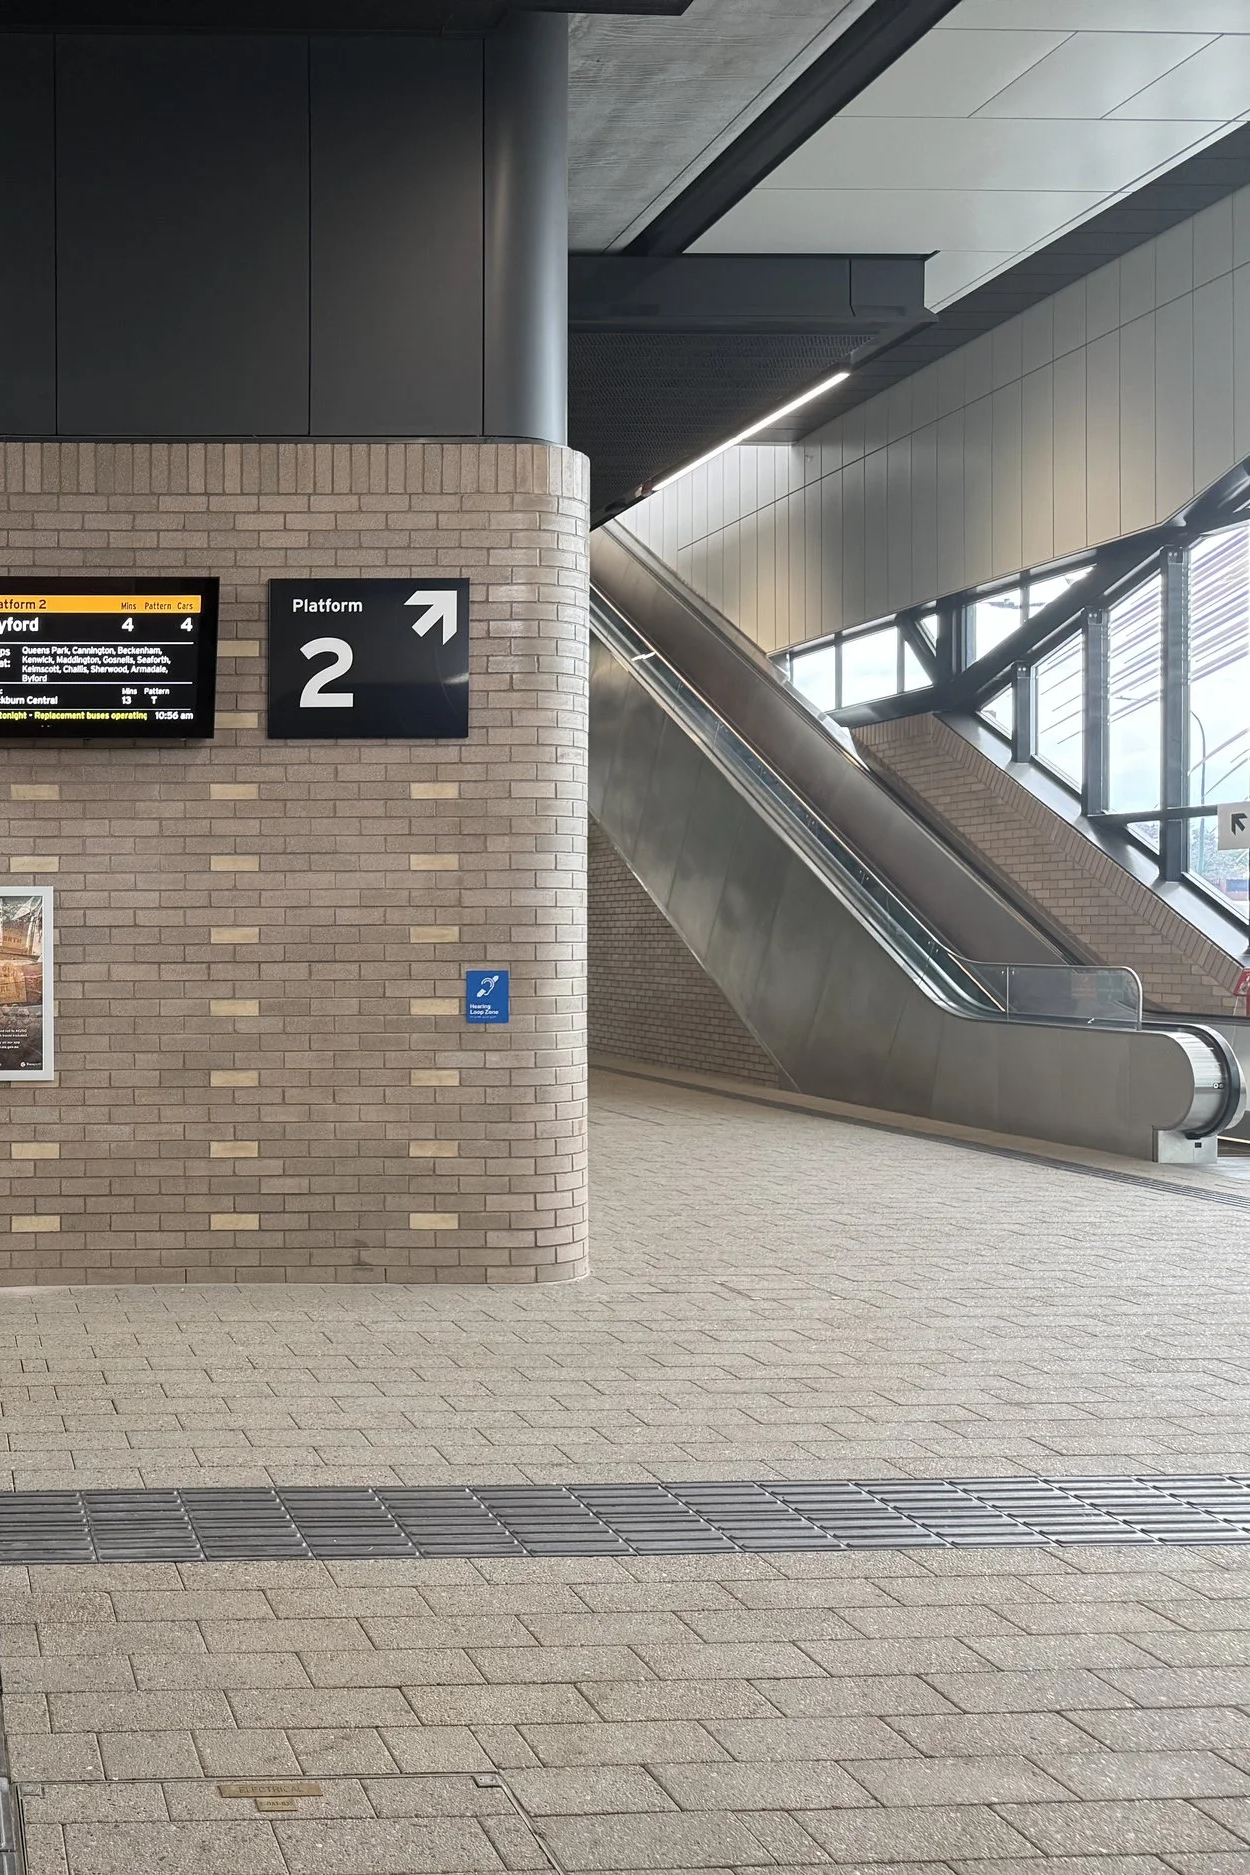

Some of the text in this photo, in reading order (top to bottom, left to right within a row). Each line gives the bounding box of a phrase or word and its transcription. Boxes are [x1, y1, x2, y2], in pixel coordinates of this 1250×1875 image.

[39, 600, 47, 610] 2
[121, 602, 137, 610] Mins
[144, 602, 172, 610] Pattern
[292, 598, 363, 613] Platform
[121, 618, 134, 631] 4
[180, 618, 193, 631] 4
[22, 646, 162, 656] Queens Park, Cannington, Beckenham,
[22, 656, 171, 665] Kenwick, Maddington, Gosnells, Seaforth,
[22, 665, 168, 674] Kelmscott, Challis, Sherwood, Armadale,
[299, 637, 354, 708] 2
[22, 674, 47, 682] Byford
[26, 696, 58, 705] Central
[122, 697, 131, 705] 13
[151, 697, 157, 705] T
[0, 711, 27, 721] tonight
[34, 711, 85, 721] Replacement
[87, 711, 109, 719] buses
[111, 711, 148, 721] operating
[155, 712, 178, 720] 10:56
[237, 1785, 304, 1794] ELECTRICAL
